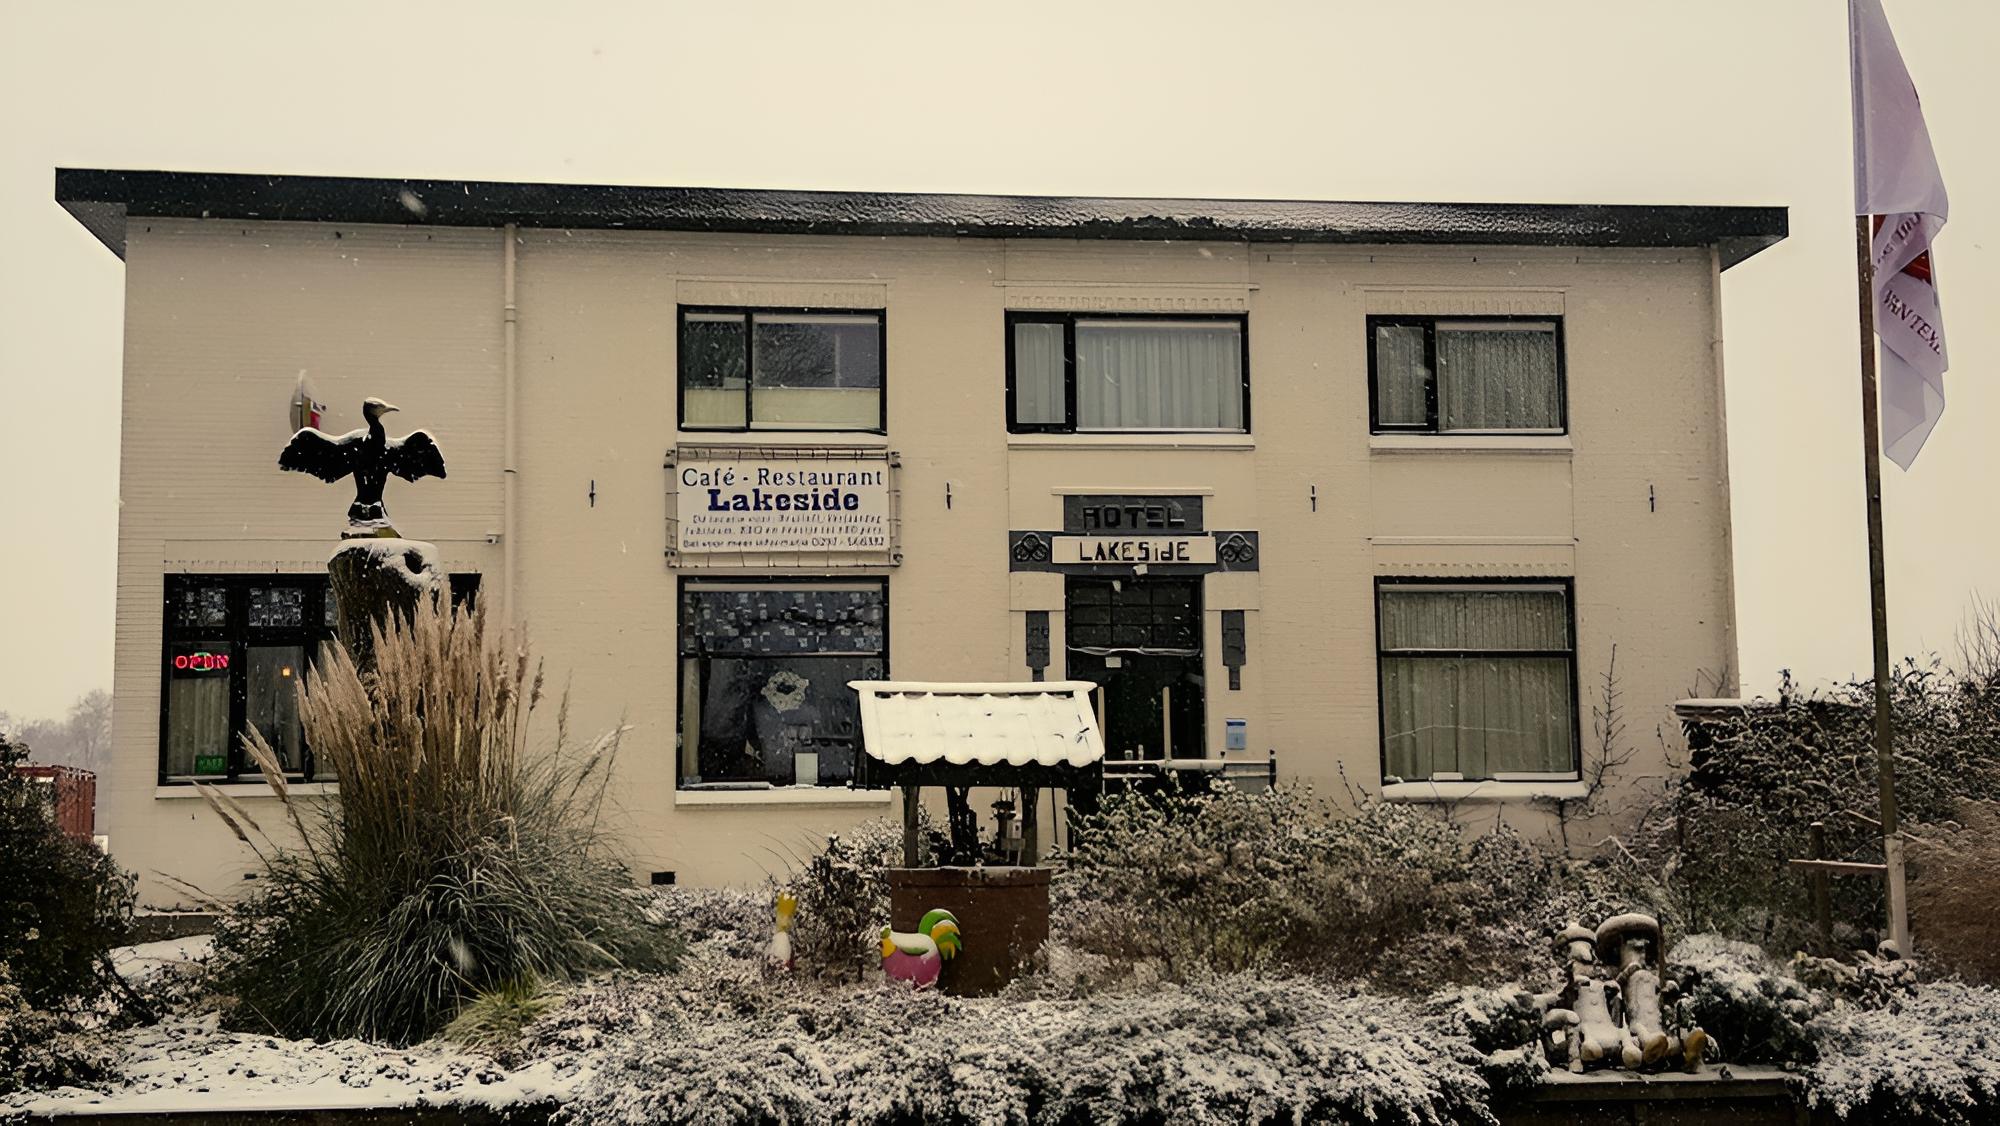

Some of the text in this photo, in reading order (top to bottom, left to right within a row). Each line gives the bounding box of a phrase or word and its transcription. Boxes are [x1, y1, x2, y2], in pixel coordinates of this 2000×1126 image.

[682, 466, 736, 487] Café
[757, 467, 882, 487] Restaurant
[707, 487, 860, 512] Lakeside
[1082, 503, 1186, 529] HOTEL
